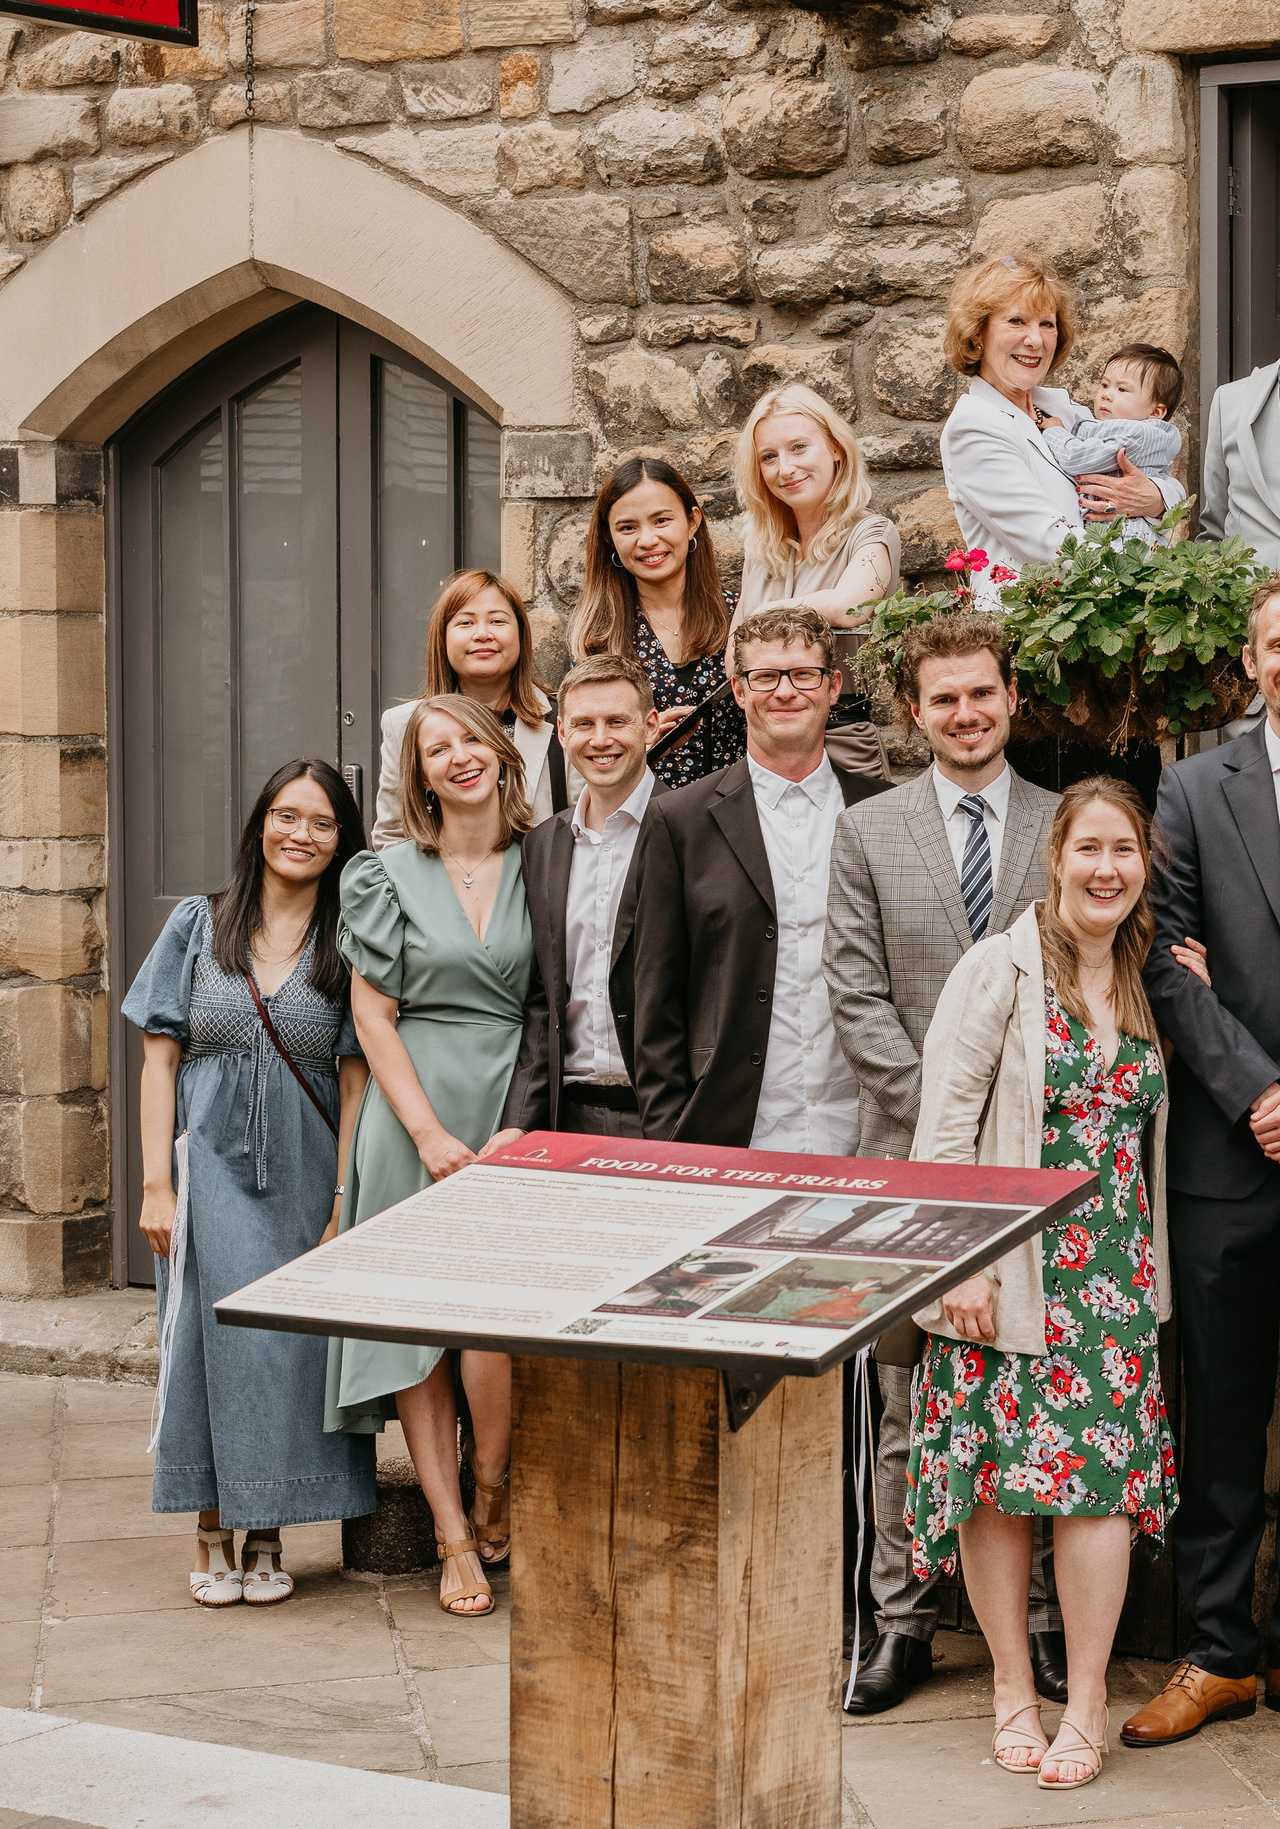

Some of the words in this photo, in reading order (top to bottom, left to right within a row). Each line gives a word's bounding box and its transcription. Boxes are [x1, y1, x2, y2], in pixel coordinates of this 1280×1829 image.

[501, 1155, 553, 1163] BLACKFRIARS
[578, 1157, 659, 1172] FOOD
[657, 1164, 718, 1178] FOR
[719, 1169, 781, 1183] THE
[778, 1173, 889, 1190] FRIARS
